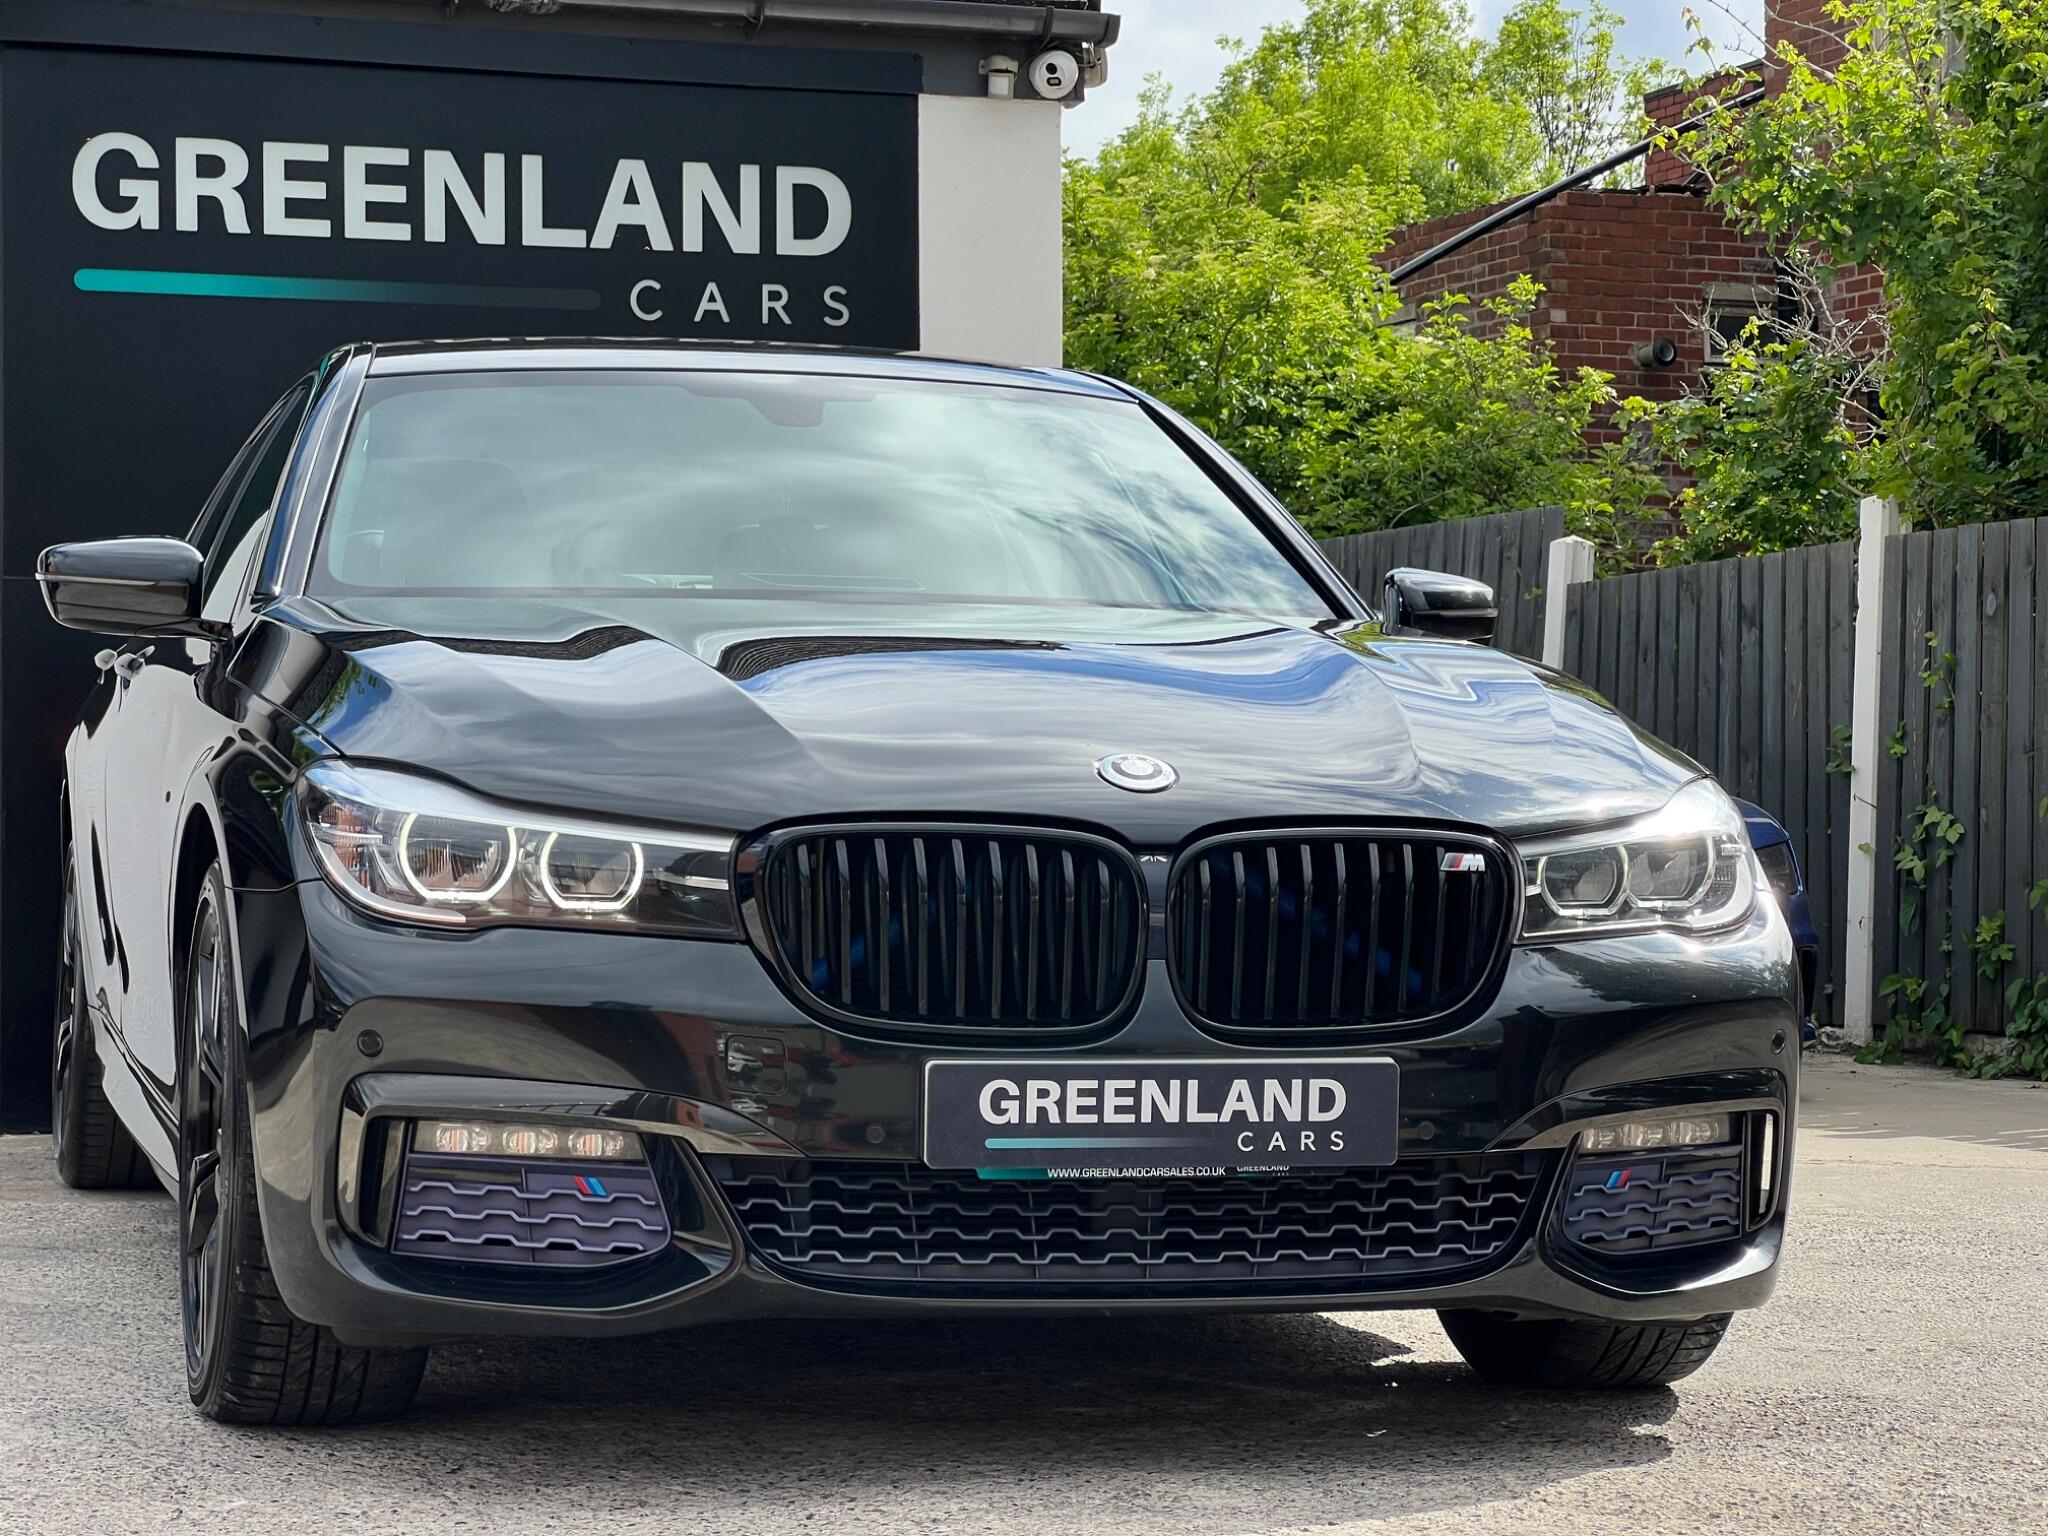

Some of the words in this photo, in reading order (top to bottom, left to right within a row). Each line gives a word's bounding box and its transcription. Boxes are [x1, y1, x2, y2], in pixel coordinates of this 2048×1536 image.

[73, 132, 852, 256] GREENLAND
[630, 279, 850, 326] CARS
[978, 1079, 1347, 1125] GREENLAND
[1237, 1130, 1345, 1152] CARS
[1047, 1166, 1226, 1178] WWW.GREENLANDCARSALES.CO.UK
